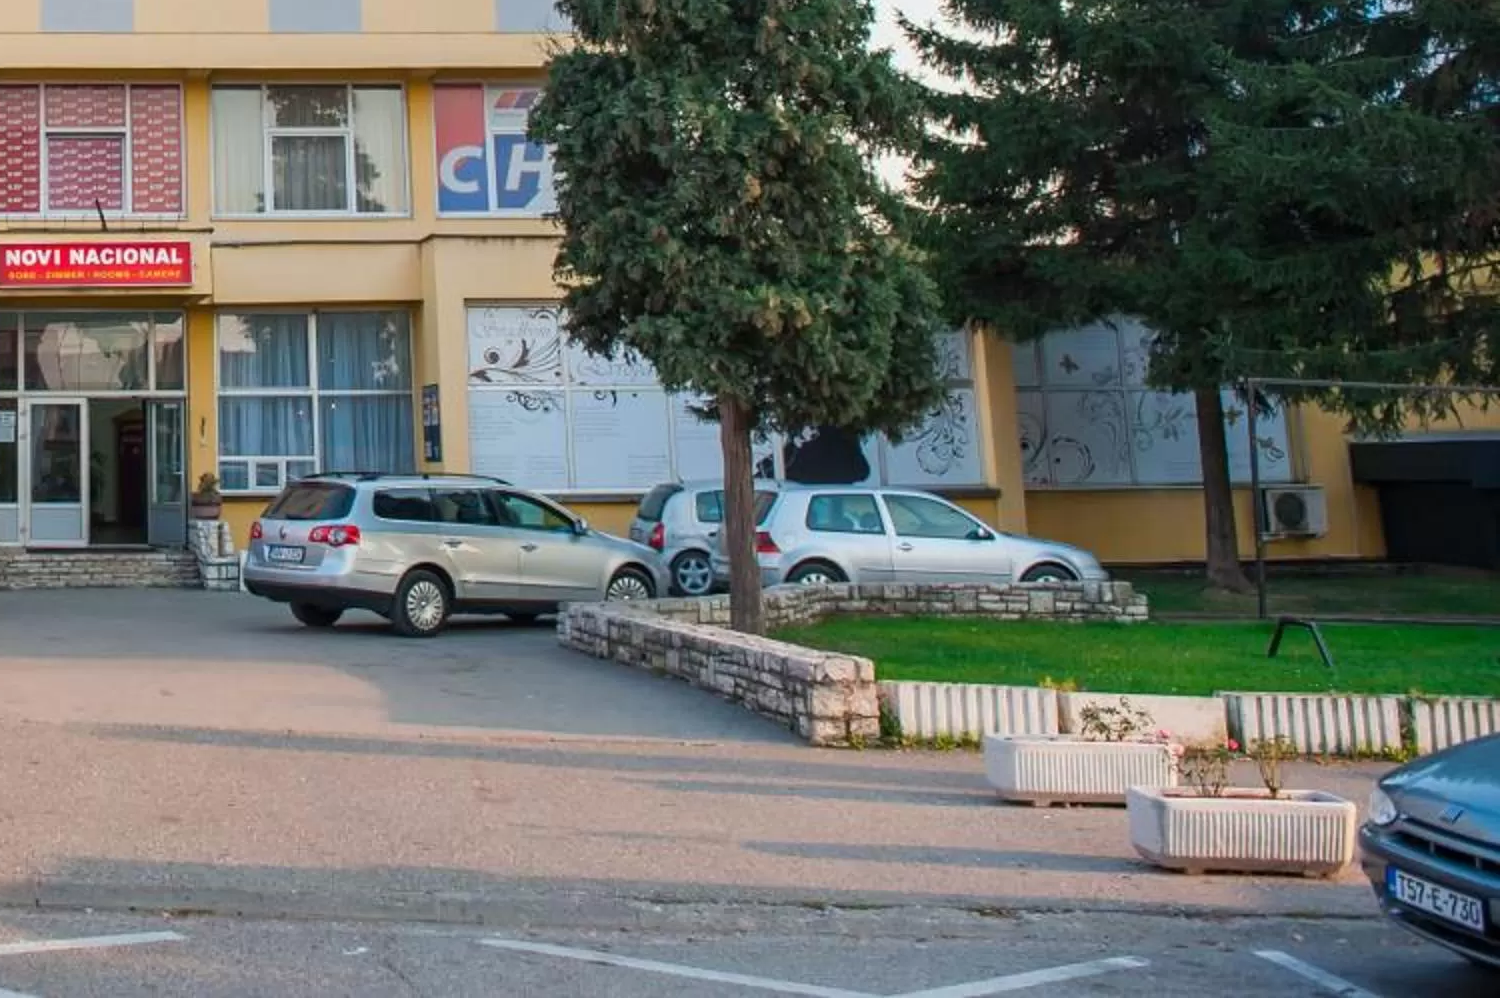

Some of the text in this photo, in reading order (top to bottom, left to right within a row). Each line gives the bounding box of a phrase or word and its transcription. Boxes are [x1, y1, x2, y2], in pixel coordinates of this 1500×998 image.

[5, 248, 183, 266] NOVI NACIONAL
[1397, 873, 1482, 925] T57-E-730
